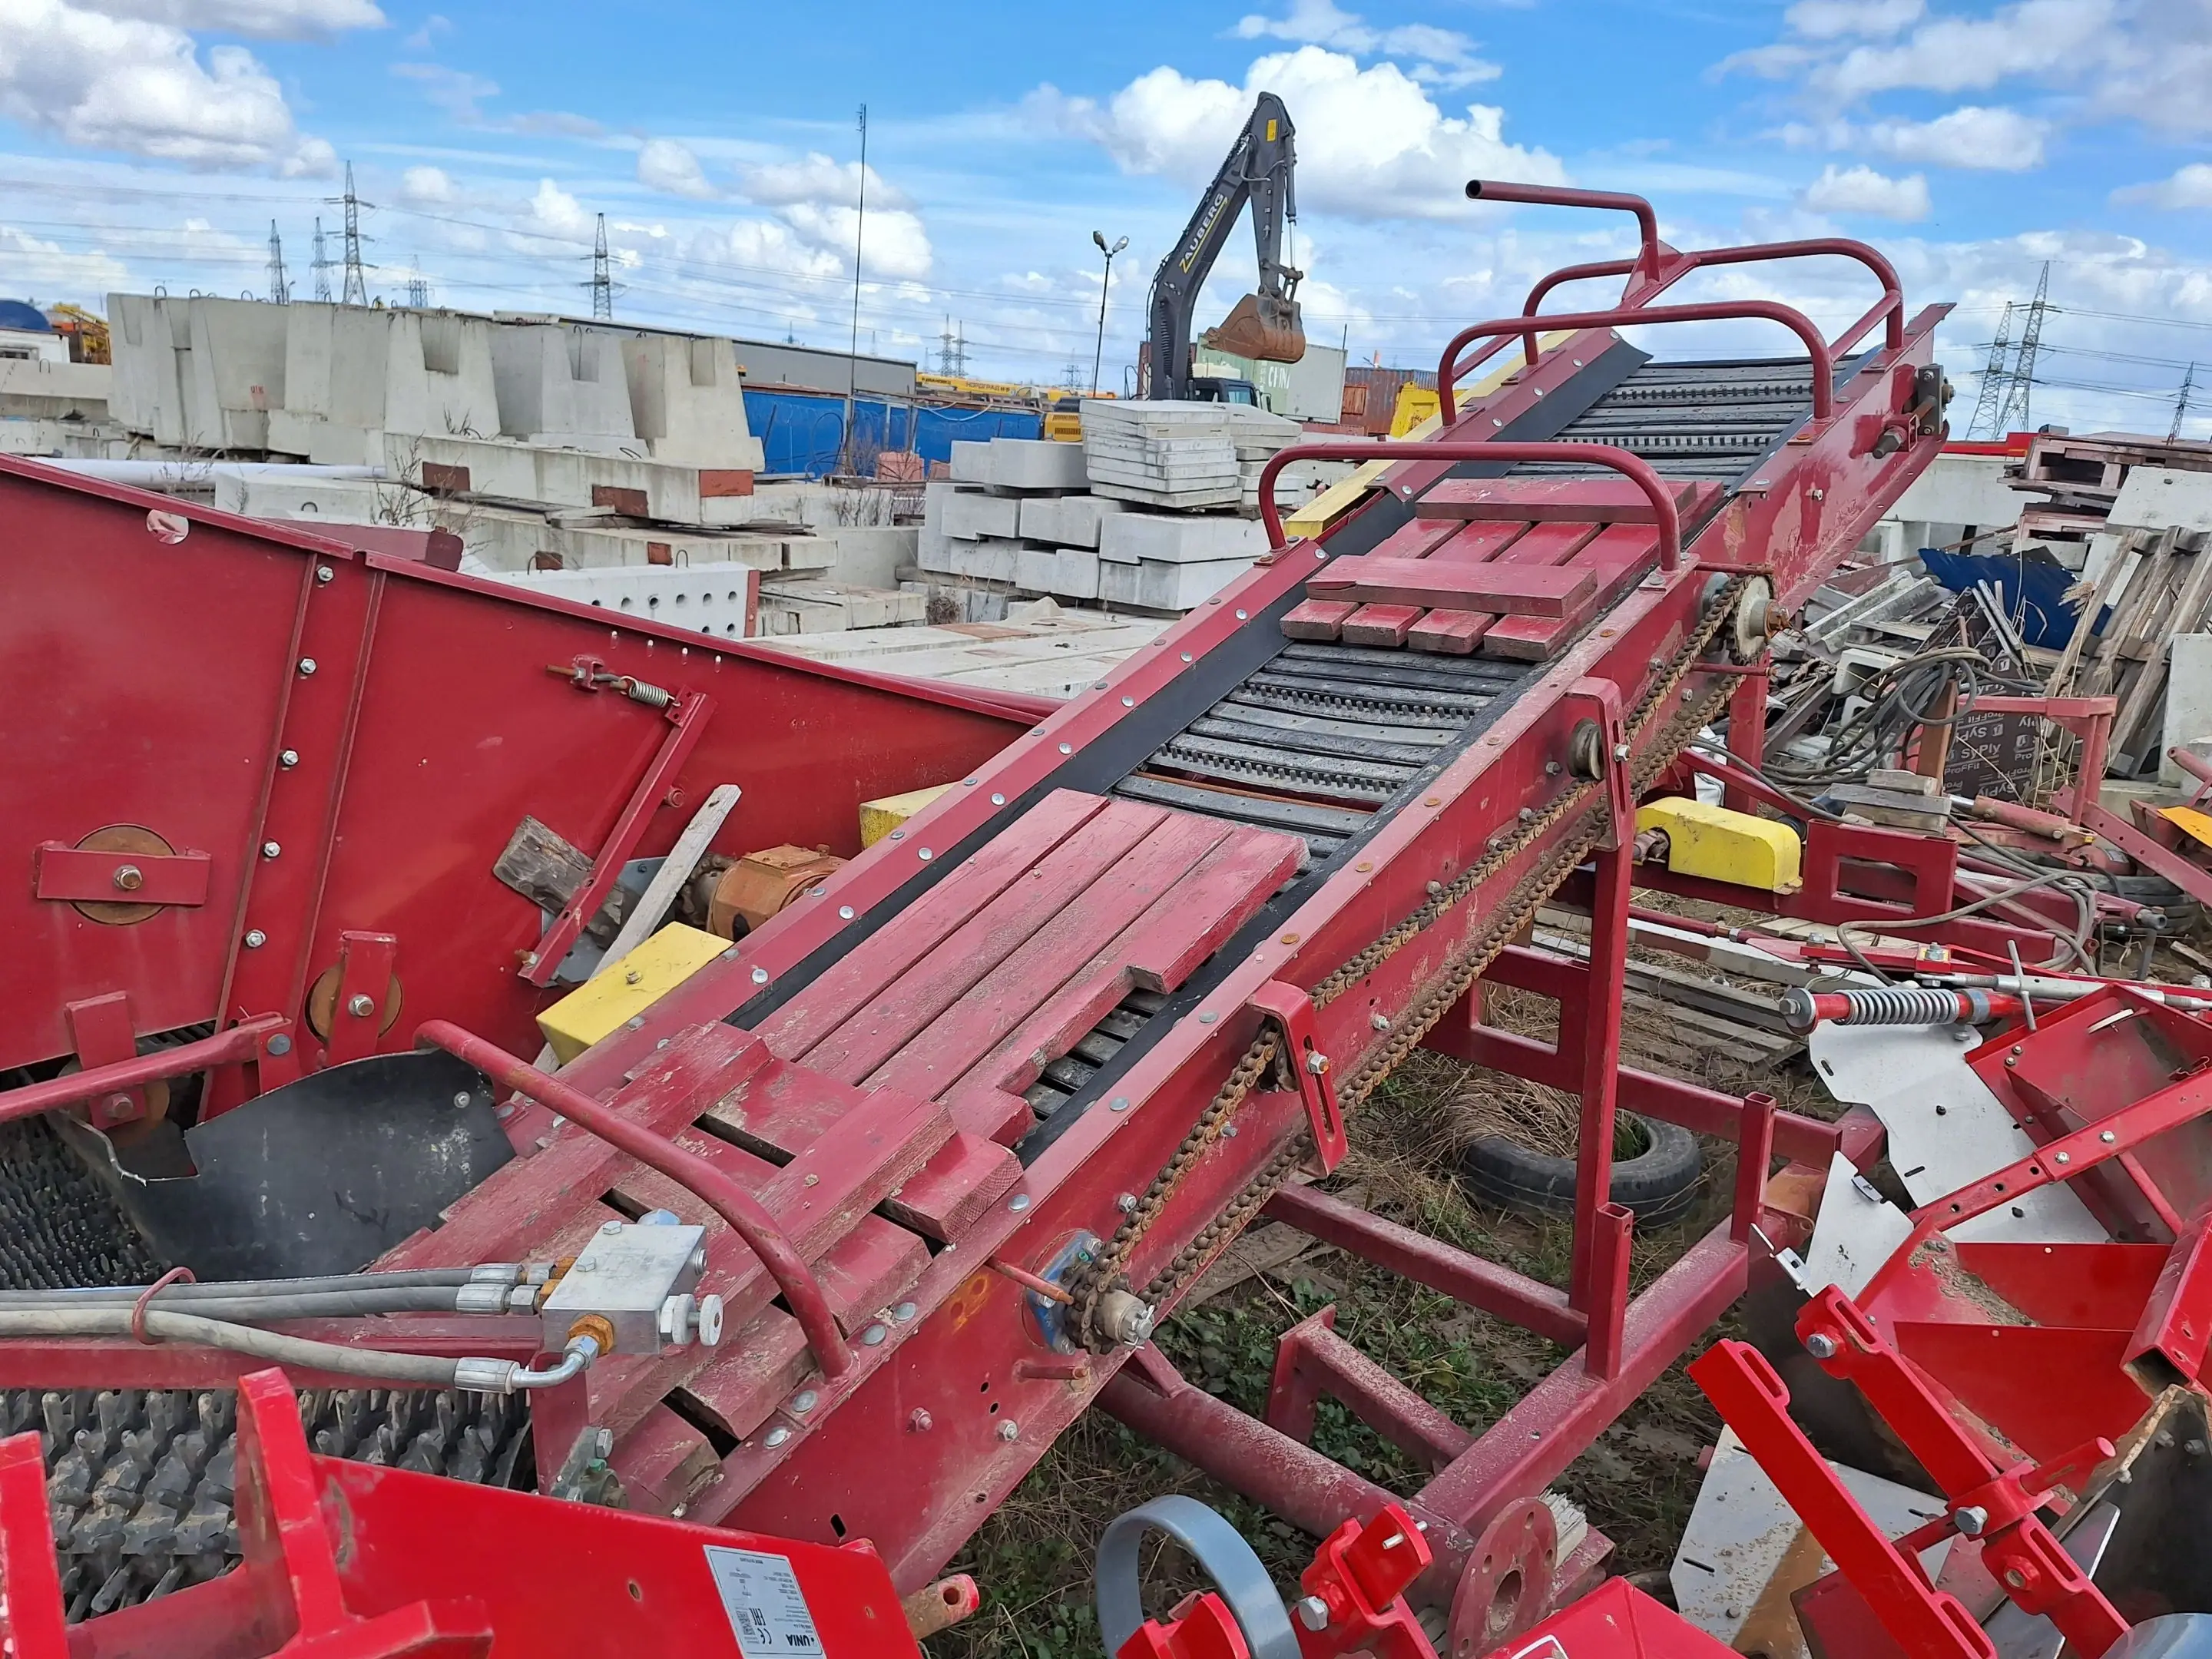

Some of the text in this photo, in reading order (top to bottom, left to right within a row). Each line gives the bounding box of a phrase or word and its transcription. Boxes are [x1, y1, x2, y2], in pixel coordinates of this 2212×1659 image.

[1178, 193, 1228, 273] ZAUBERG
[1960, 743, 2002, 760] SyPly
[1944, 763, 1981, 775] ProFFit
[785, 1634, 811, 1647] UNIA
